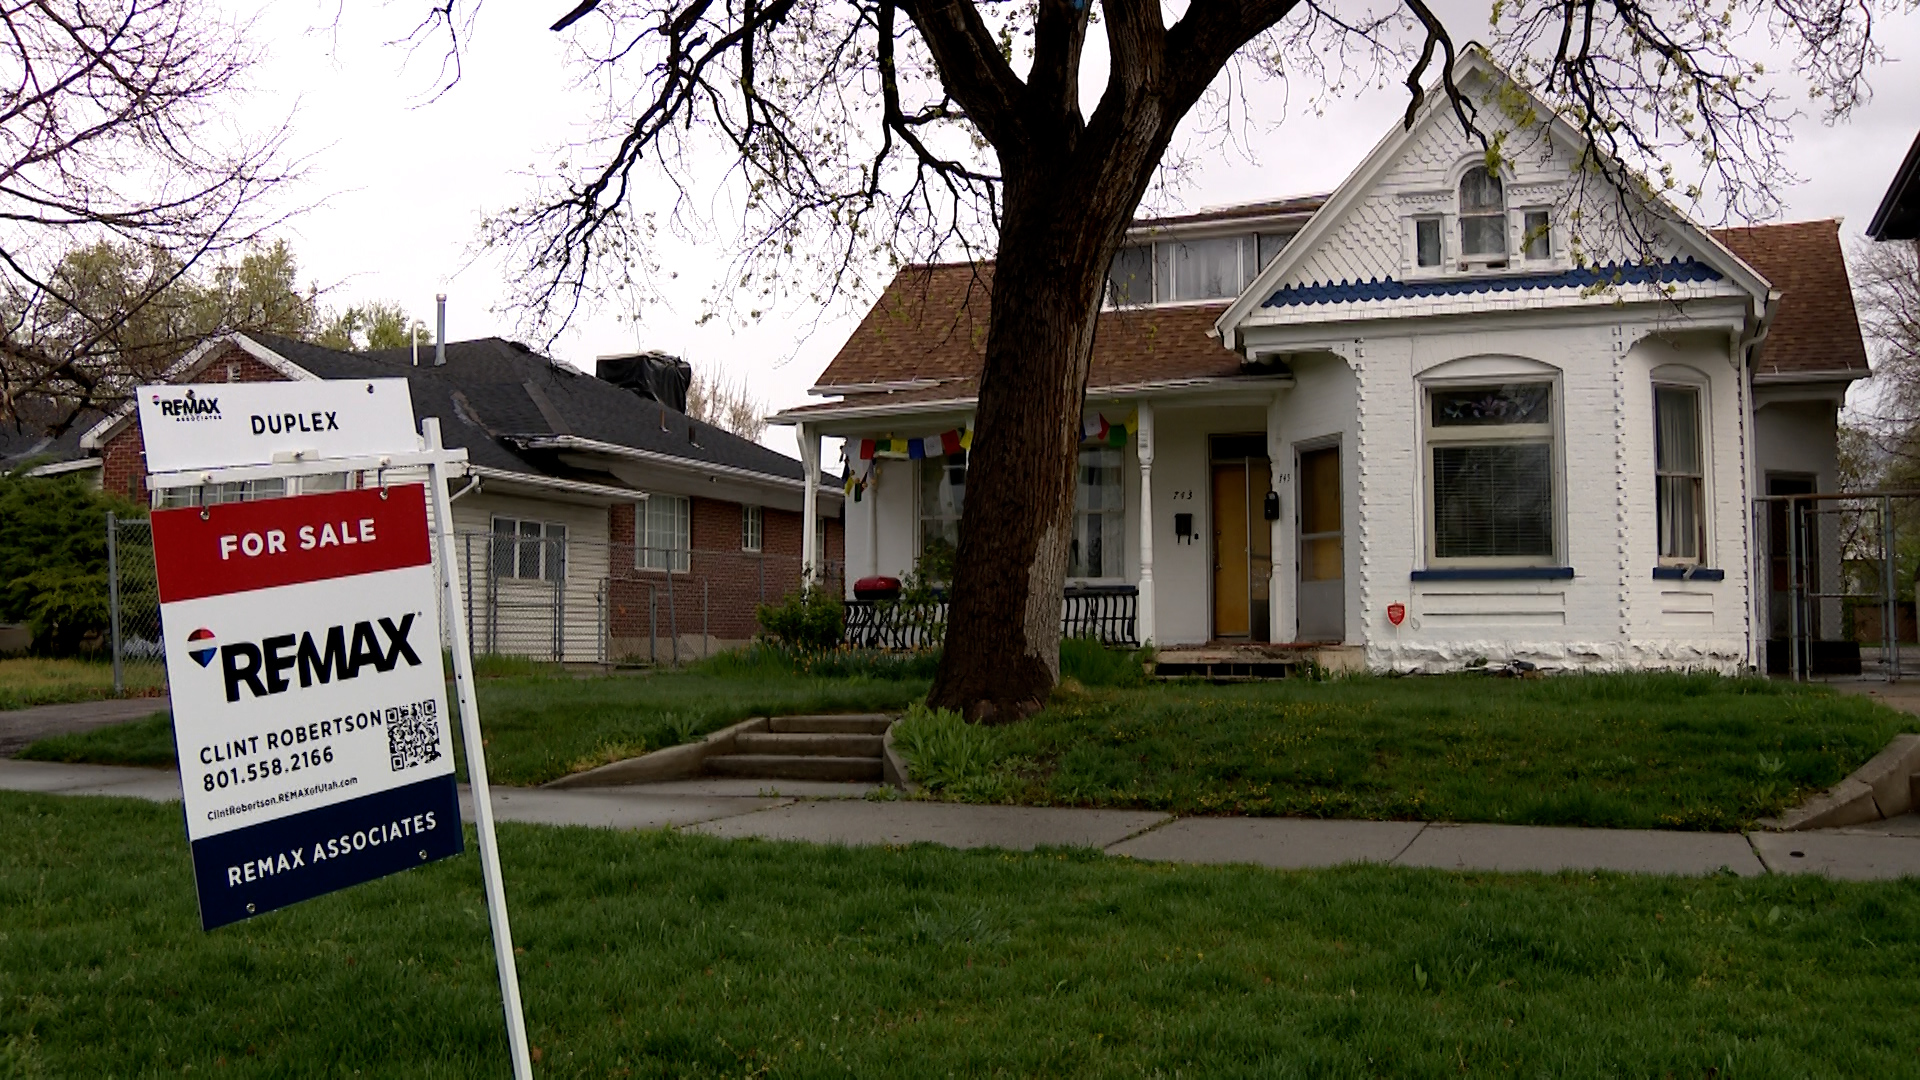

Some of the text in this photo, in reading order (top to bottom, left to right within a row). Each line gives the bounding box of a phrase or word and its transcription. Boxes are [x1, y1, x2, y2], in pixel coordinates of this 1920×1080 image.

[161, 398, 220, 416] REMAX
[251, 411, 339, 435] DUPLEX
[220, 518, 377, 560] FOR SALE
[221, 612, 423, 703] REMAX
[200, 709, 383, 765] CLINT ROBERTSON
[203, 746, 334, 792] 801.558.2166
[207, 776, 358, 821] ClintRobertson.REMAXofUtah.com
[227, 811, 437, 887] REMAX ASSOCIATES
